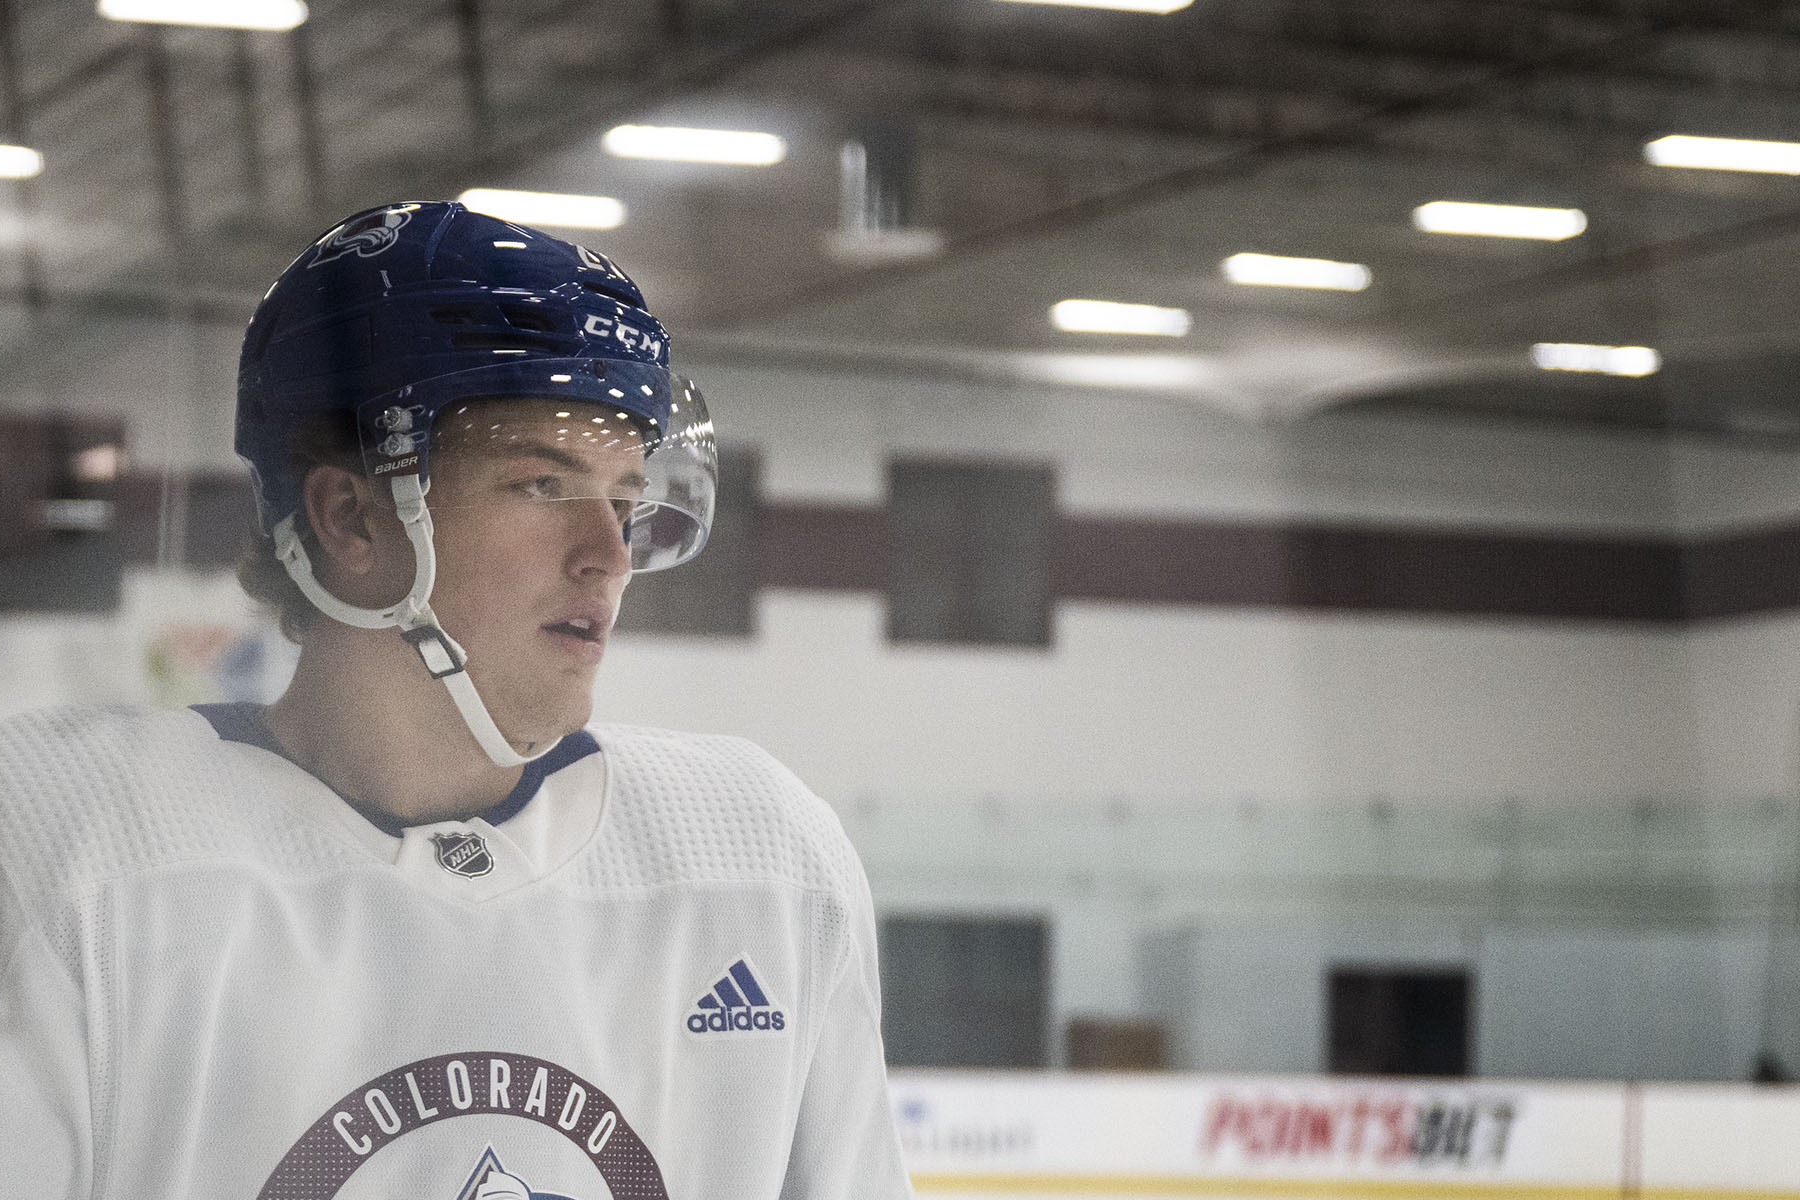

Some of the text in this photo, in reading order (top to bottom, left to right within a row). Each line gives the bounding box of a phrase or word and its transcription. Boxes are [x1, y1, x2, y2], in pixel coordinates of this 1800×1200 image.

[584, 313, 662, 360] CCM
[449, 841, 481, 867] NHL
[687, 1006, 785, 1033] adidas
[333, 1059, 617, 1155] COLORADO
